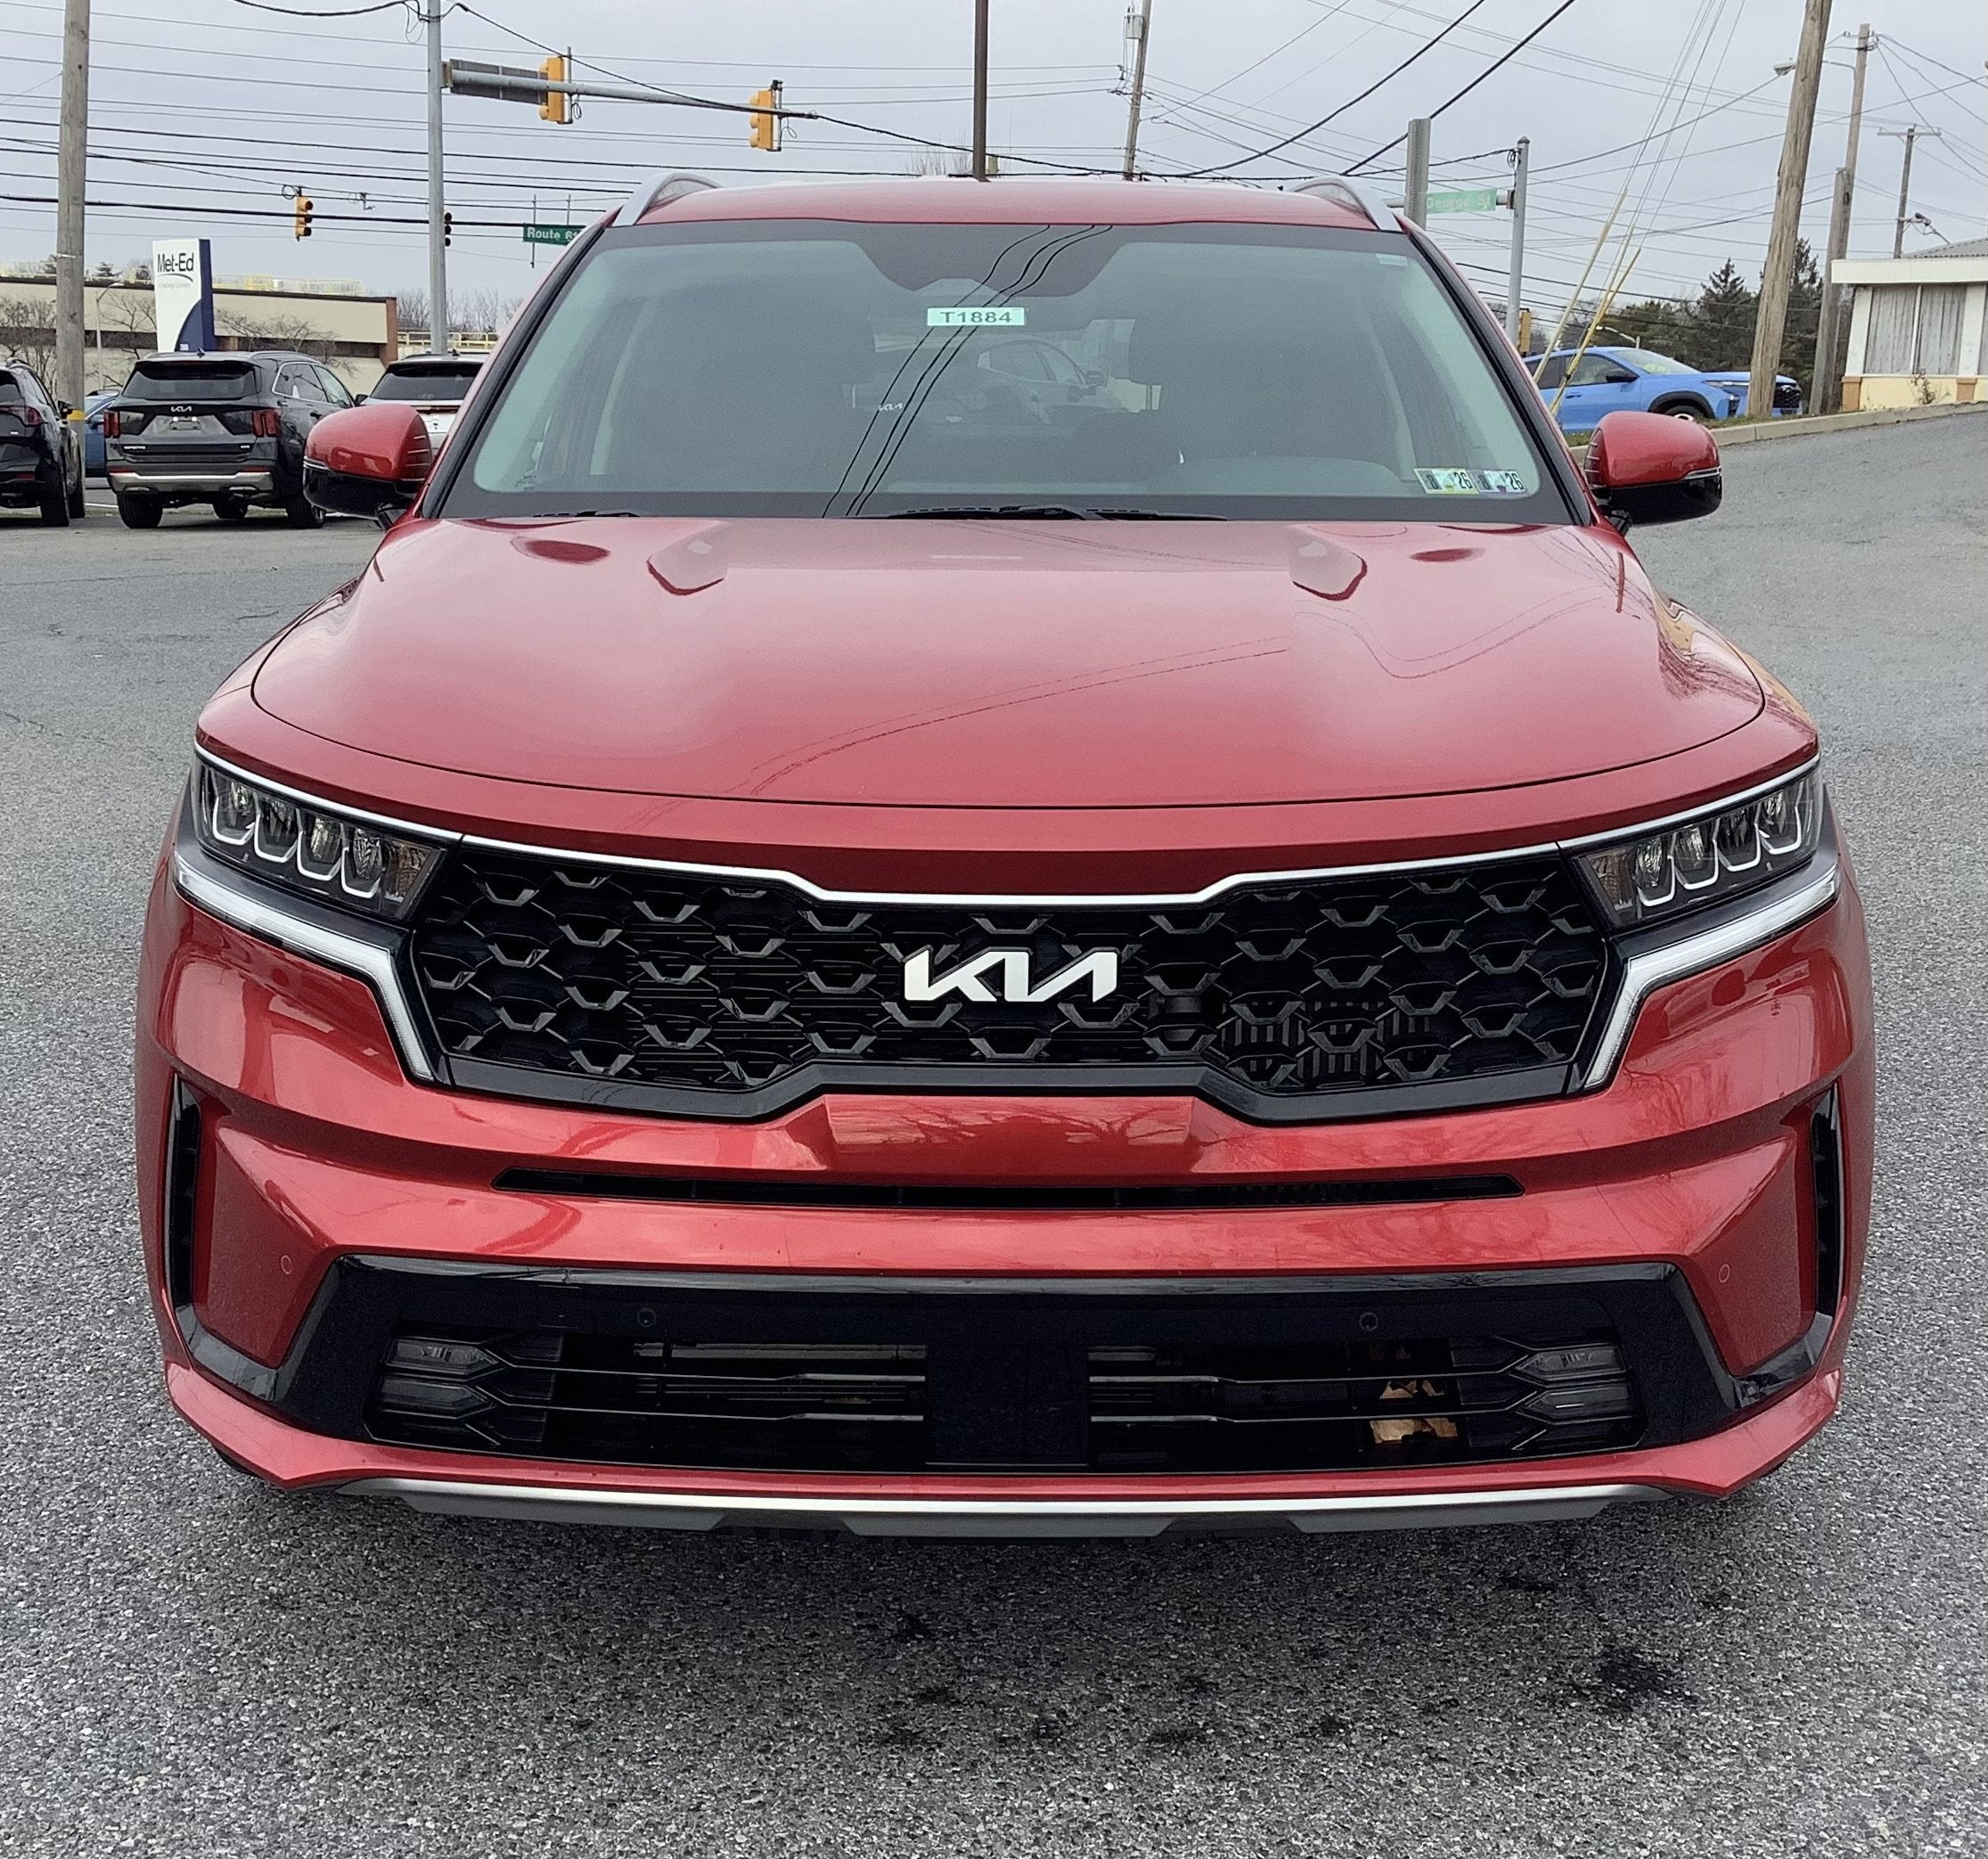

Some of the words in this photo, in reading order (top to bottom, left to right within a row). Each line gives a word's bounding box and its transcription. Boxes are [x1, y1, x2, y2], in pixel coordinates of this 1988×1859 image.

[527, 226, 561, 240] Route
[157, 252, 194, 273] Met-Ed
[940, 311, 1012, 323] T1884
[1453, 471, 1473, 489] 26
[1504, 472, 1525, 490] 26
[904, 947, 1118, 1003] KIA
